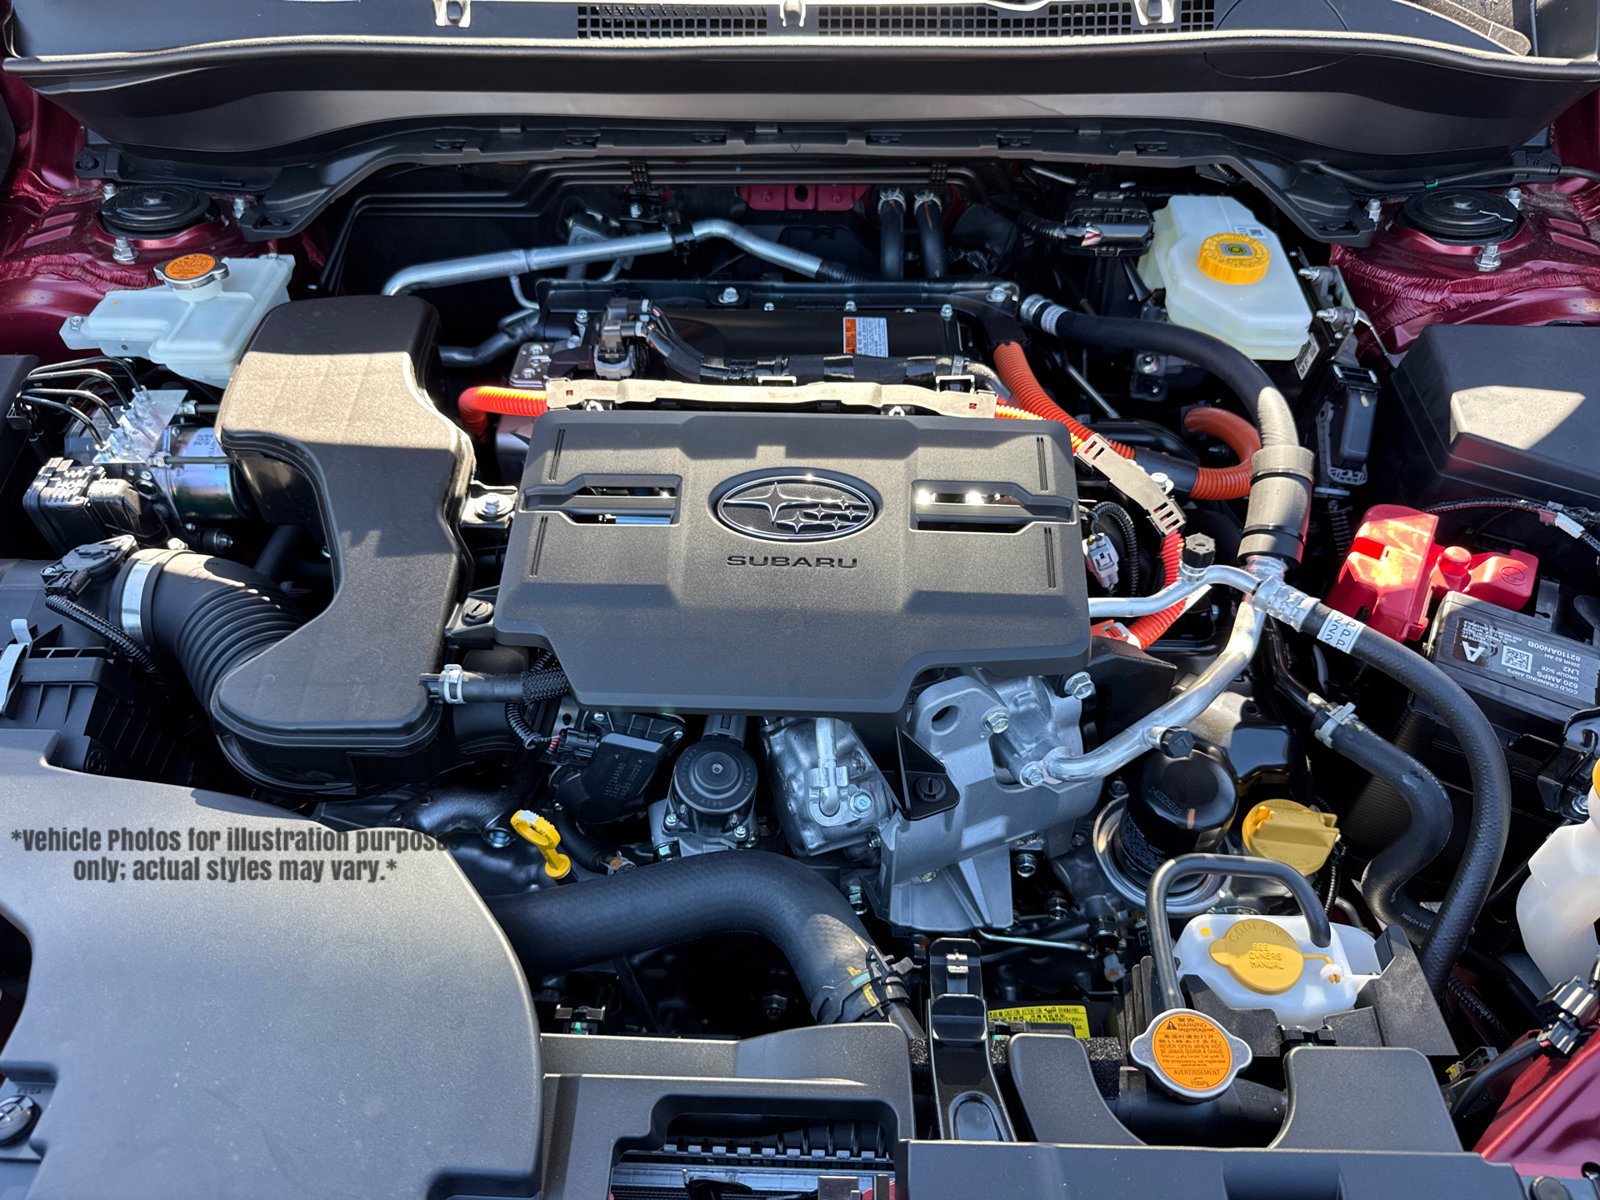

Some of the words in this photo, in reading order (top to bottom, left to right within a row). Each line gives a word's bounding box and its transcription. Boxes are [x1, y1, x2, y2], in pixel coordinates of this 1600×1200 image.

[727, 556, 857, 568] SUBARU
[1506, 668, 1524, 678] AMPS
[1541, 666, 1555, 674] SIZE
[1562, 666, 1580, 676] LN2
[1536, 671, 1562, 683] AMPS
[1556, 670, 1579, 681] GROUP
[1526, 674, 1559, 689] CRANKING
[1563, 680, 1579, 689] 620
[1560, 685, 1578, 695] COLD
[1252, 942, 1268, 952] SEE
[1250, 960, 1284, 969] MANUAL
